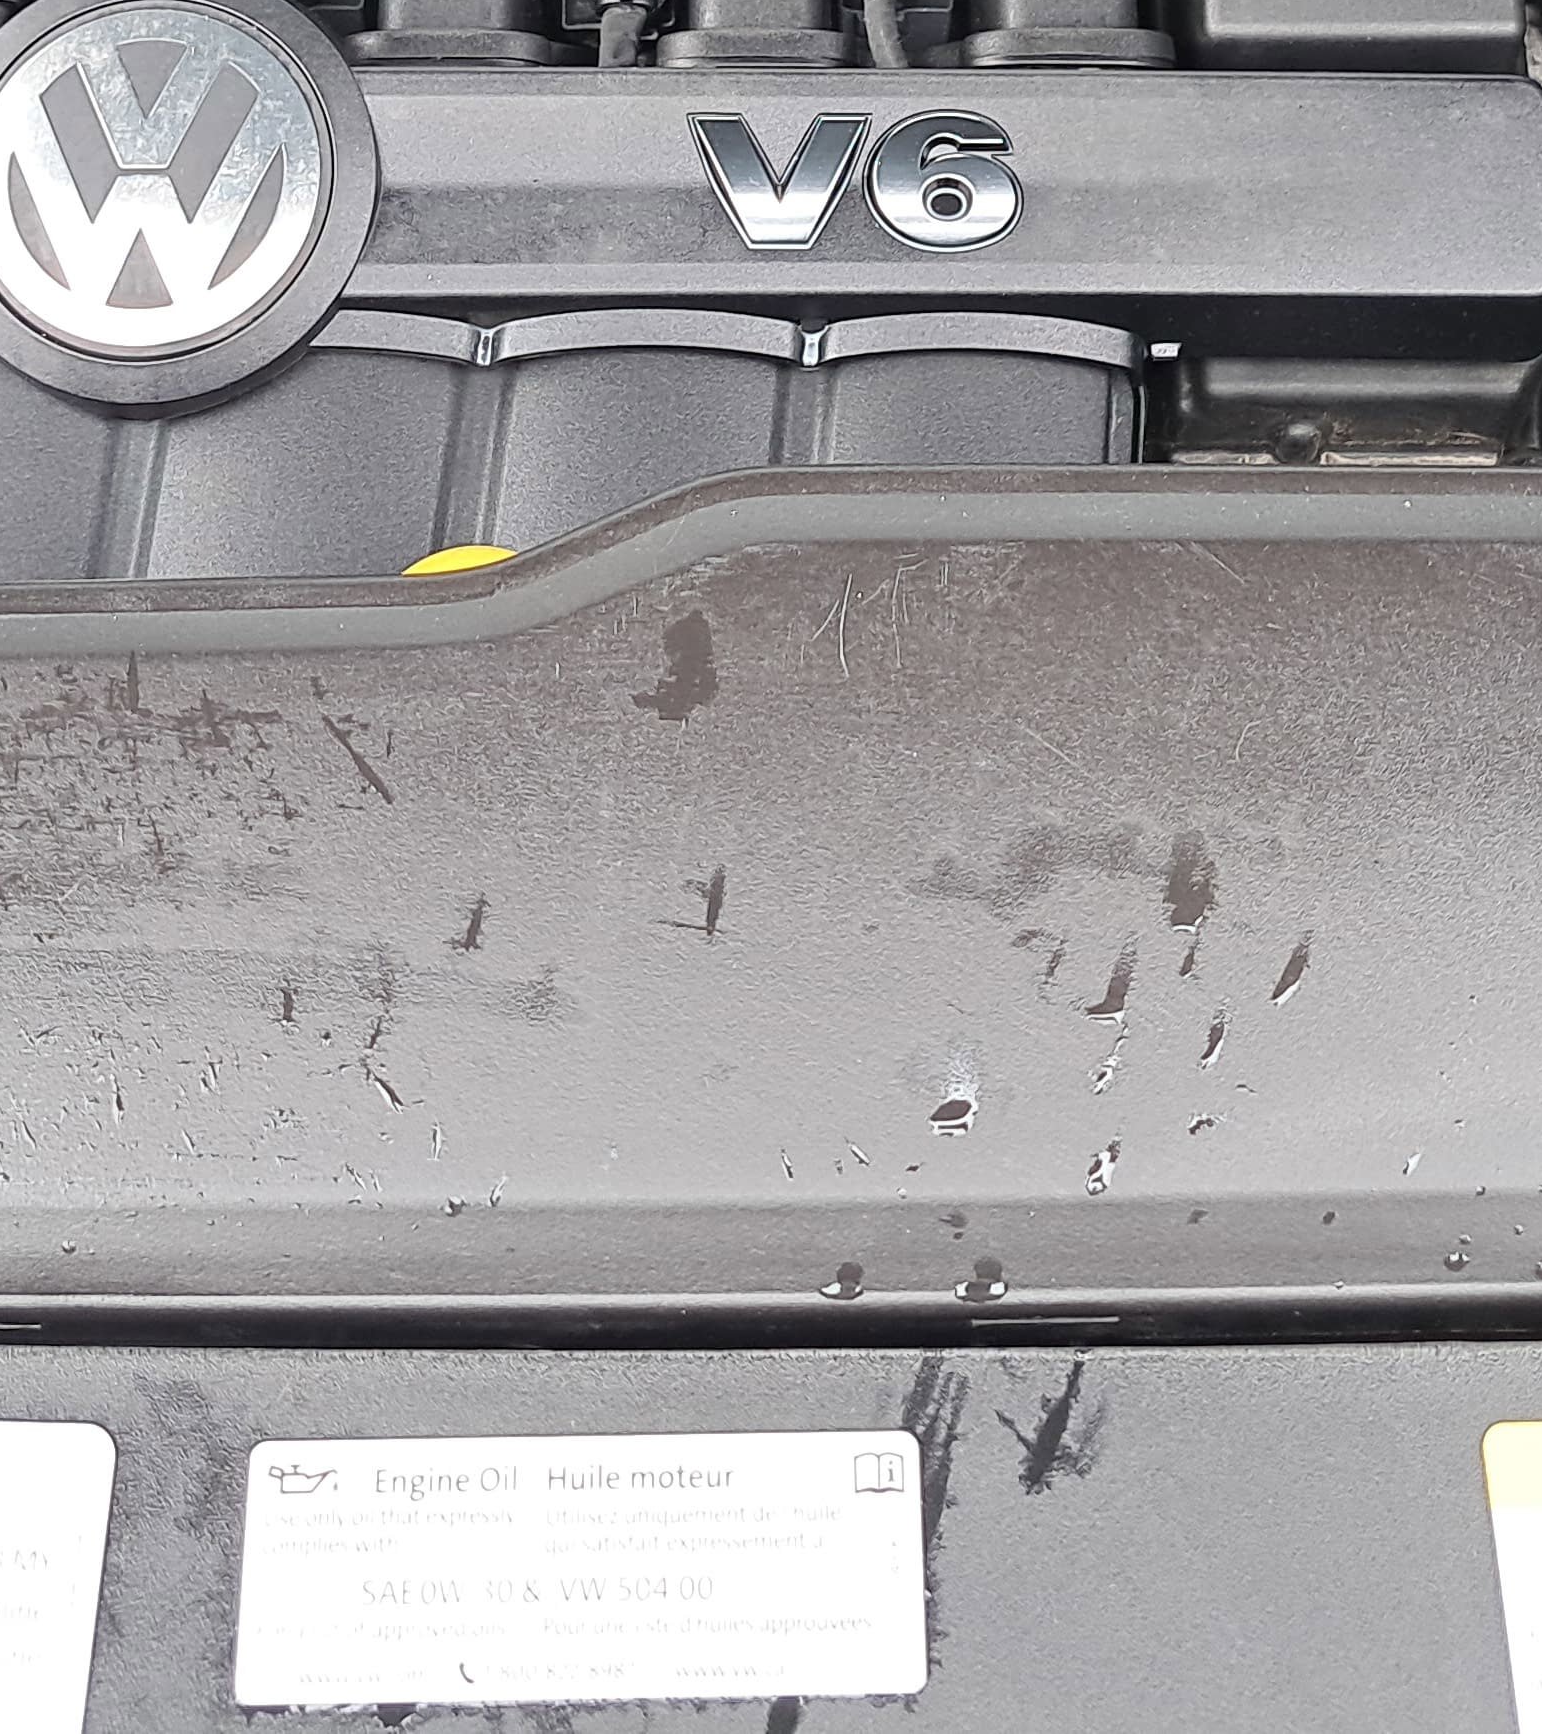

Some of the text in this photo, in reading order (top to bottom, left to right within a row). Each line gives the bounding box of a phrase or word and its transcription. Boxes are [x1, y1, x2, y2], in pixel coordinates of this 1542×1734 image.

[686, 108, 1025, 254] V6
[373, 1464, 735, 1502] Engine Oil Huile moteur
[361, 1578, 412, 1606] SAE
[522, 1577, 541, 1601] &
[560, 1575, 607, 1602] VW
[618, 1574, 669, 1602] 504
[679, 1574, 715, 1601] 00
